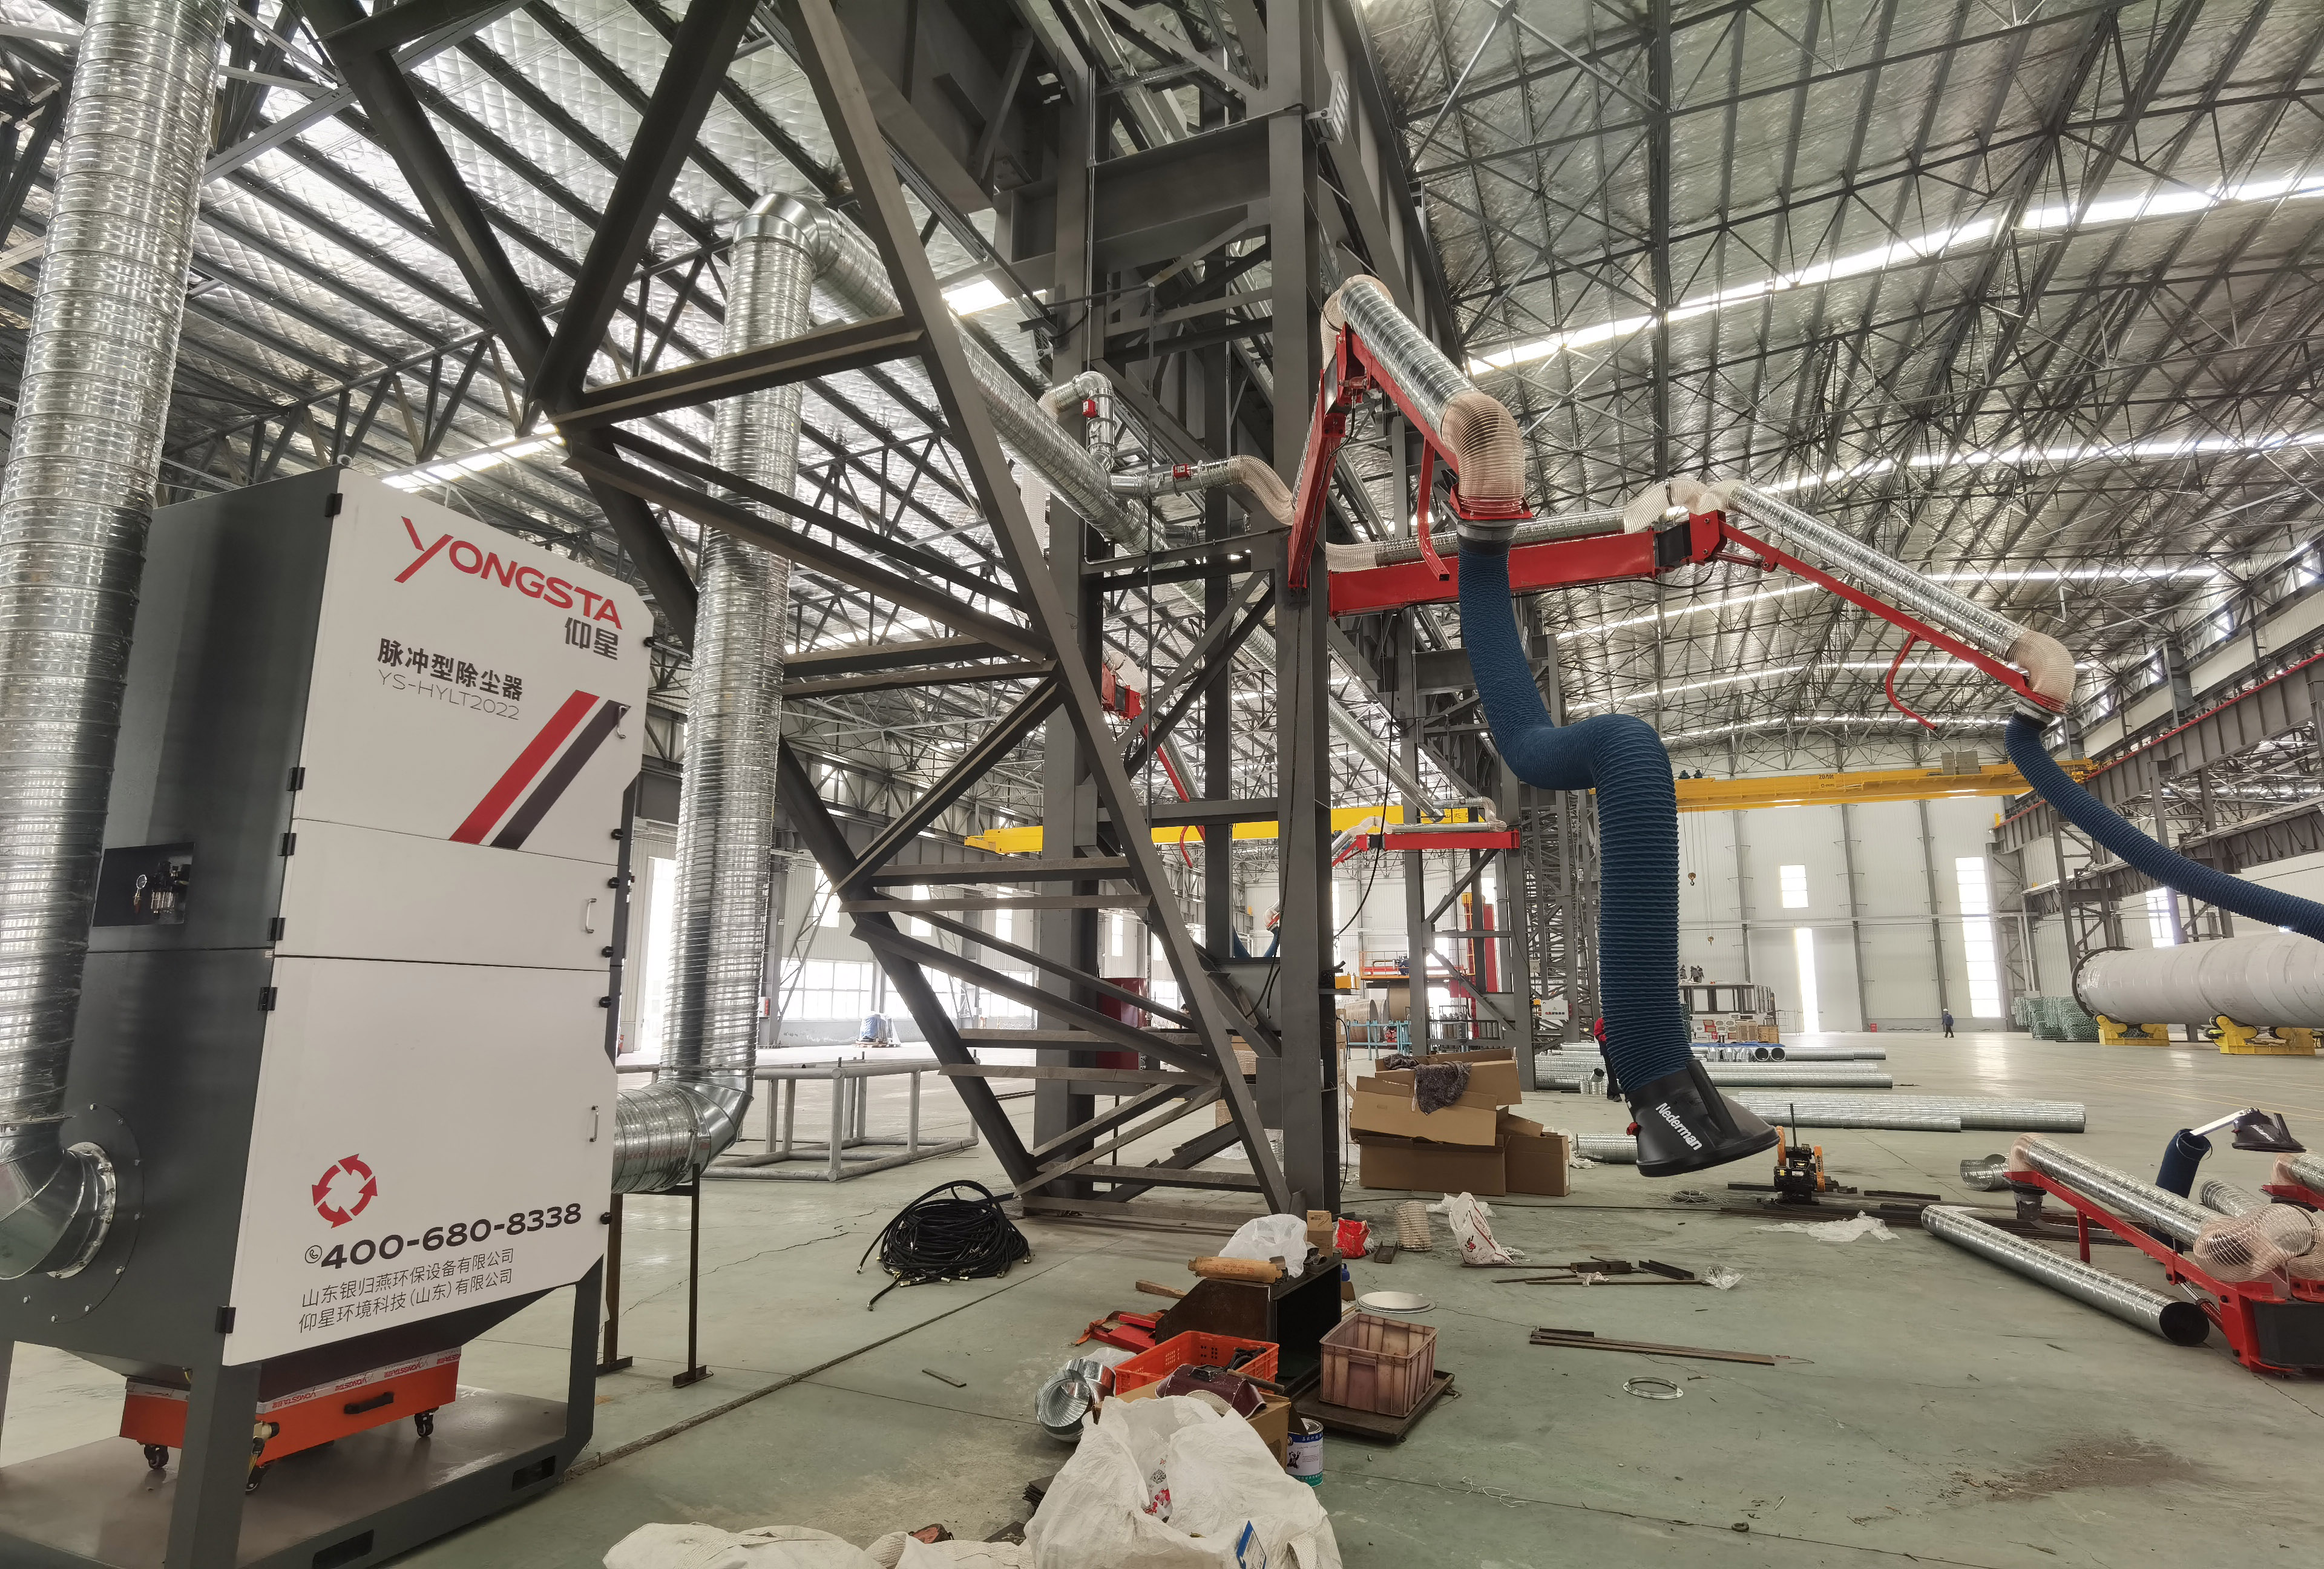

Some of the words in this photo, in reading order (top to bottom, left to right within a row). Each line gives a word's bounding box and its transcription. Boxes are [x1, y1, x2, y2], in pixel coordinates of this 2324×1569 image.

[395, 516, 622, 630] YONGSTA
[565, 617, 619, 660] 仰星
[377, 638, 522, 702] 脉冲型除尘器
[378, 669, 520, 720] YS-HYLT2022
[1656, 1102, 1702, 1151] Nederman
[321, 1203, 582, 1269] 400-680-8338
[301, 1248, 514, 1307] 山东银归燕环保设备有限公司
